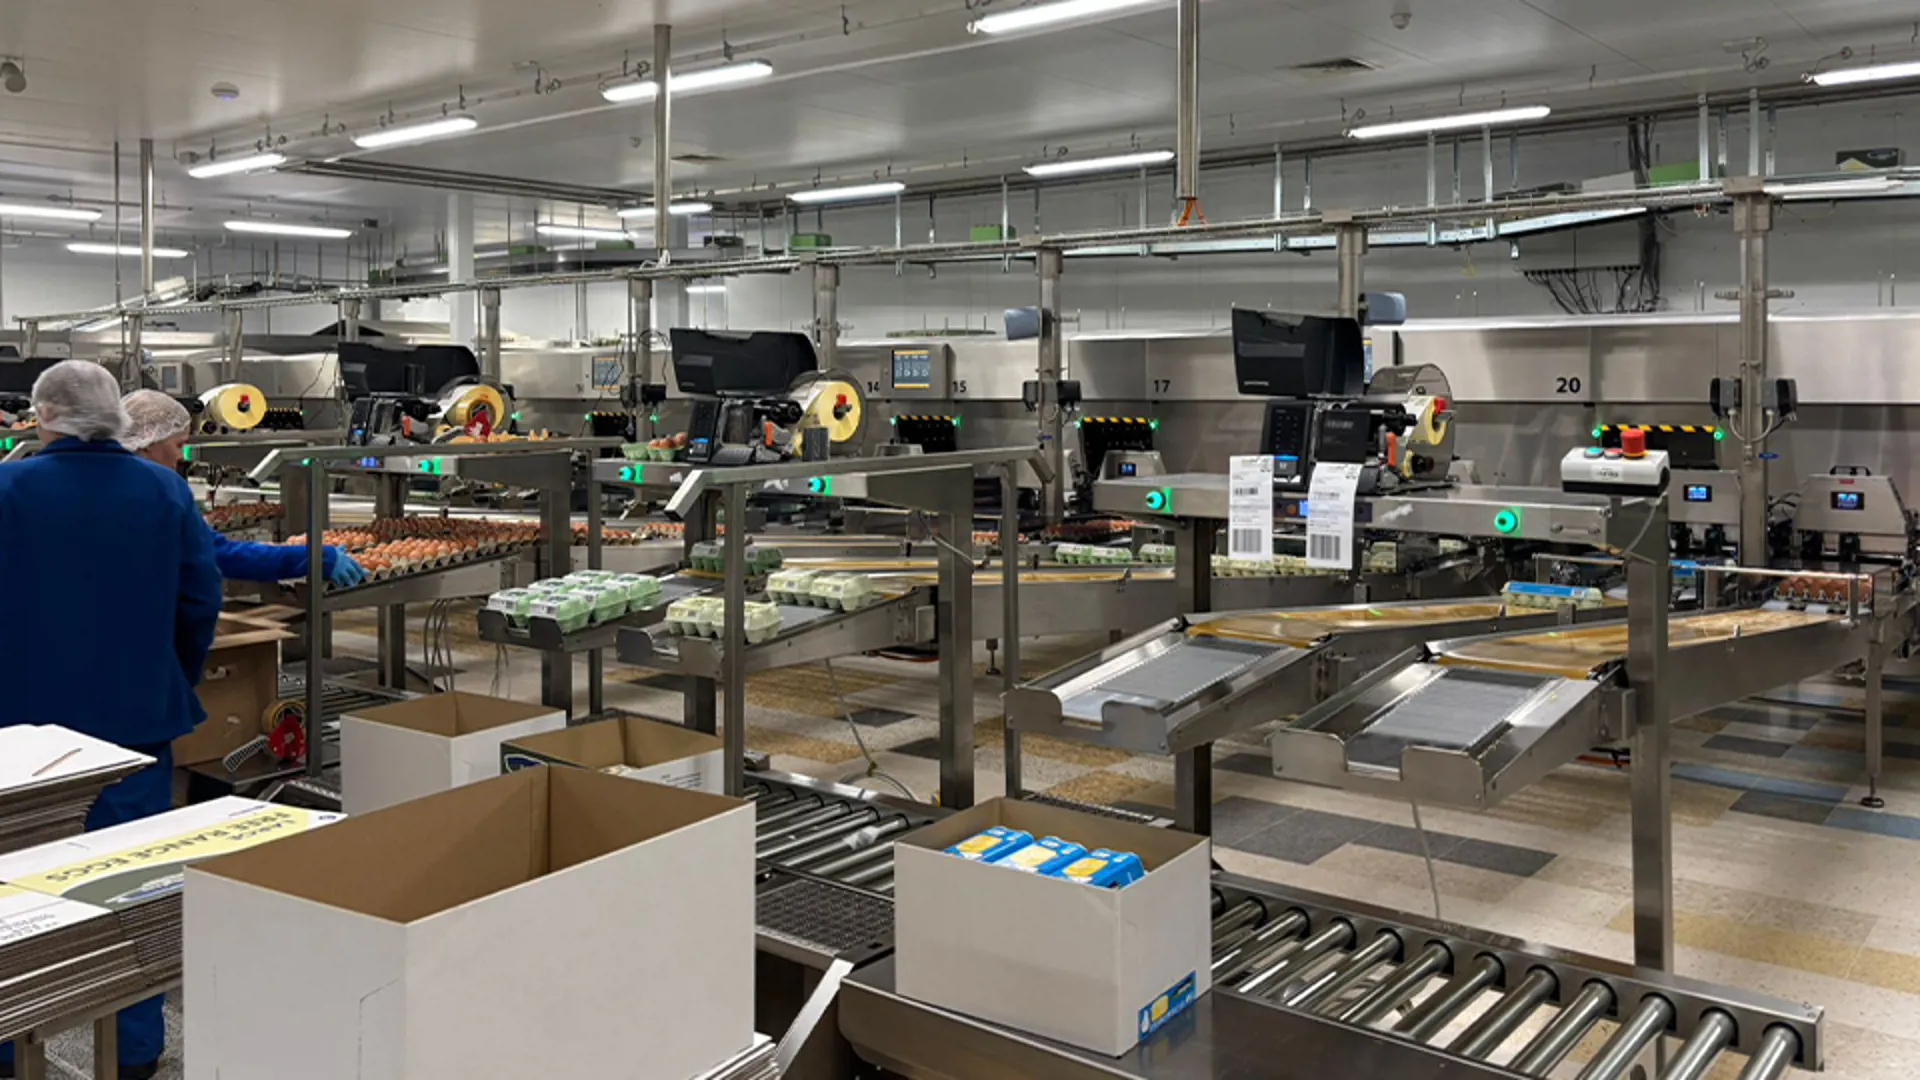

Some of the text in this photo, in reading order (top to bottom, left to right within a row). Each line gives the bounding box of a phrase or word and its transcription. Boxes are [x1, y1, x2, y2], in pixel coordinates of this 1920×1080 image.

[867, 381, 880, 393] 14
[952, 380, 967, 393] 15
[1153, 379, 1171, 393] 17
[1556, 376, 1581, 393] 20
[45, 811, 292, 882] FREE RANGE EGGS
